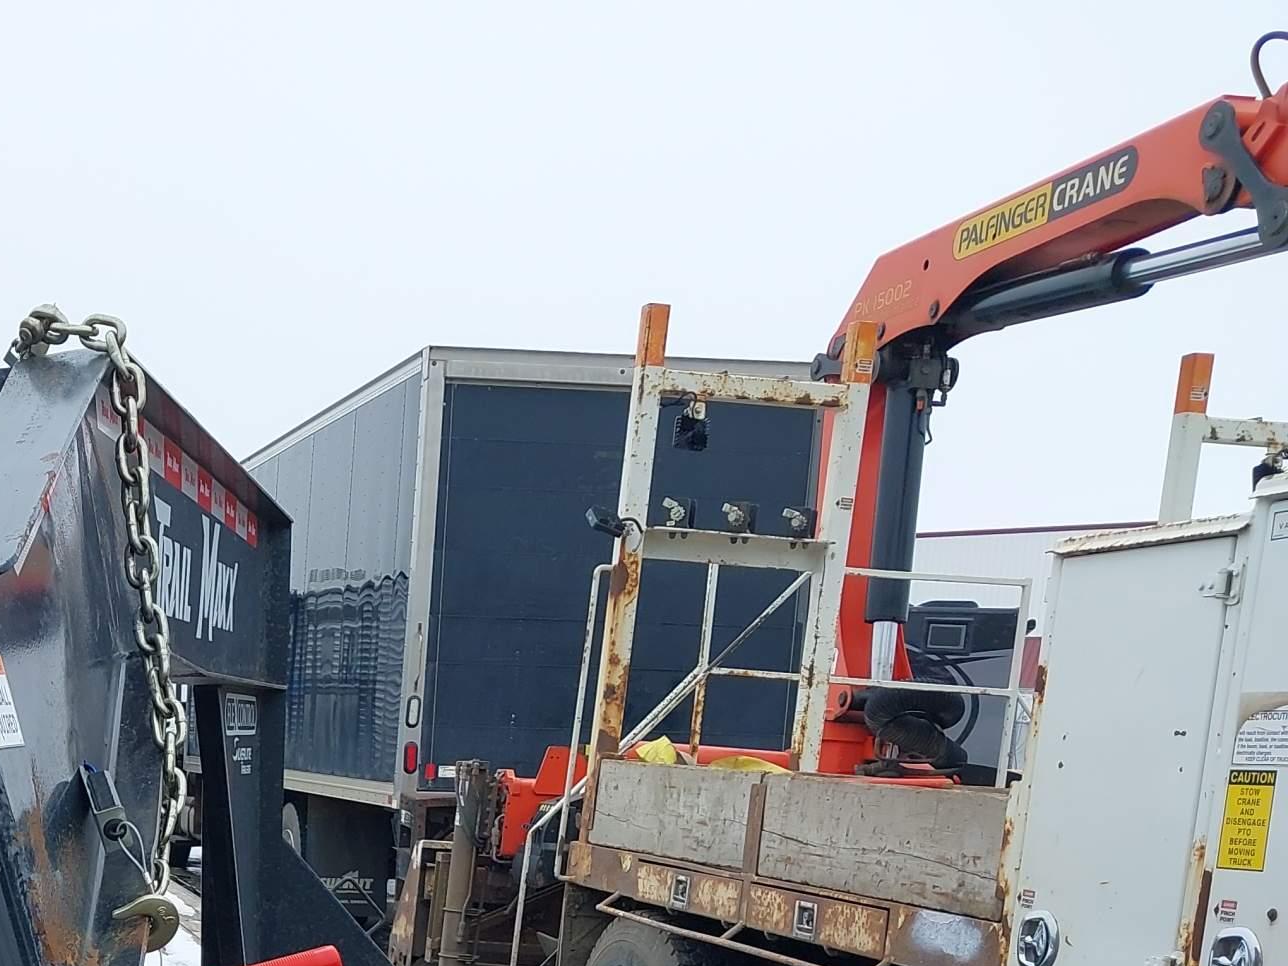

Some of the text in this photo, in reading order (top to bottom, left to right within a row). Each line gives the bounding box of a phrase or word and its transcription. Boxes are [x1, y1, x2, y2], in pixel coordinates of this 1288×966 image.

[958, 154, 1129, 253] PALFINGER CRANE
[873, 280, 912, 310] 15002
[1231, 772, 1275, 784] CAUTION
[1226, 818, 1266, 826] DISENGAGE
[1229, 838, 1256, 846] BEFORE
[1228, 848, 1256, 856] MOVING
